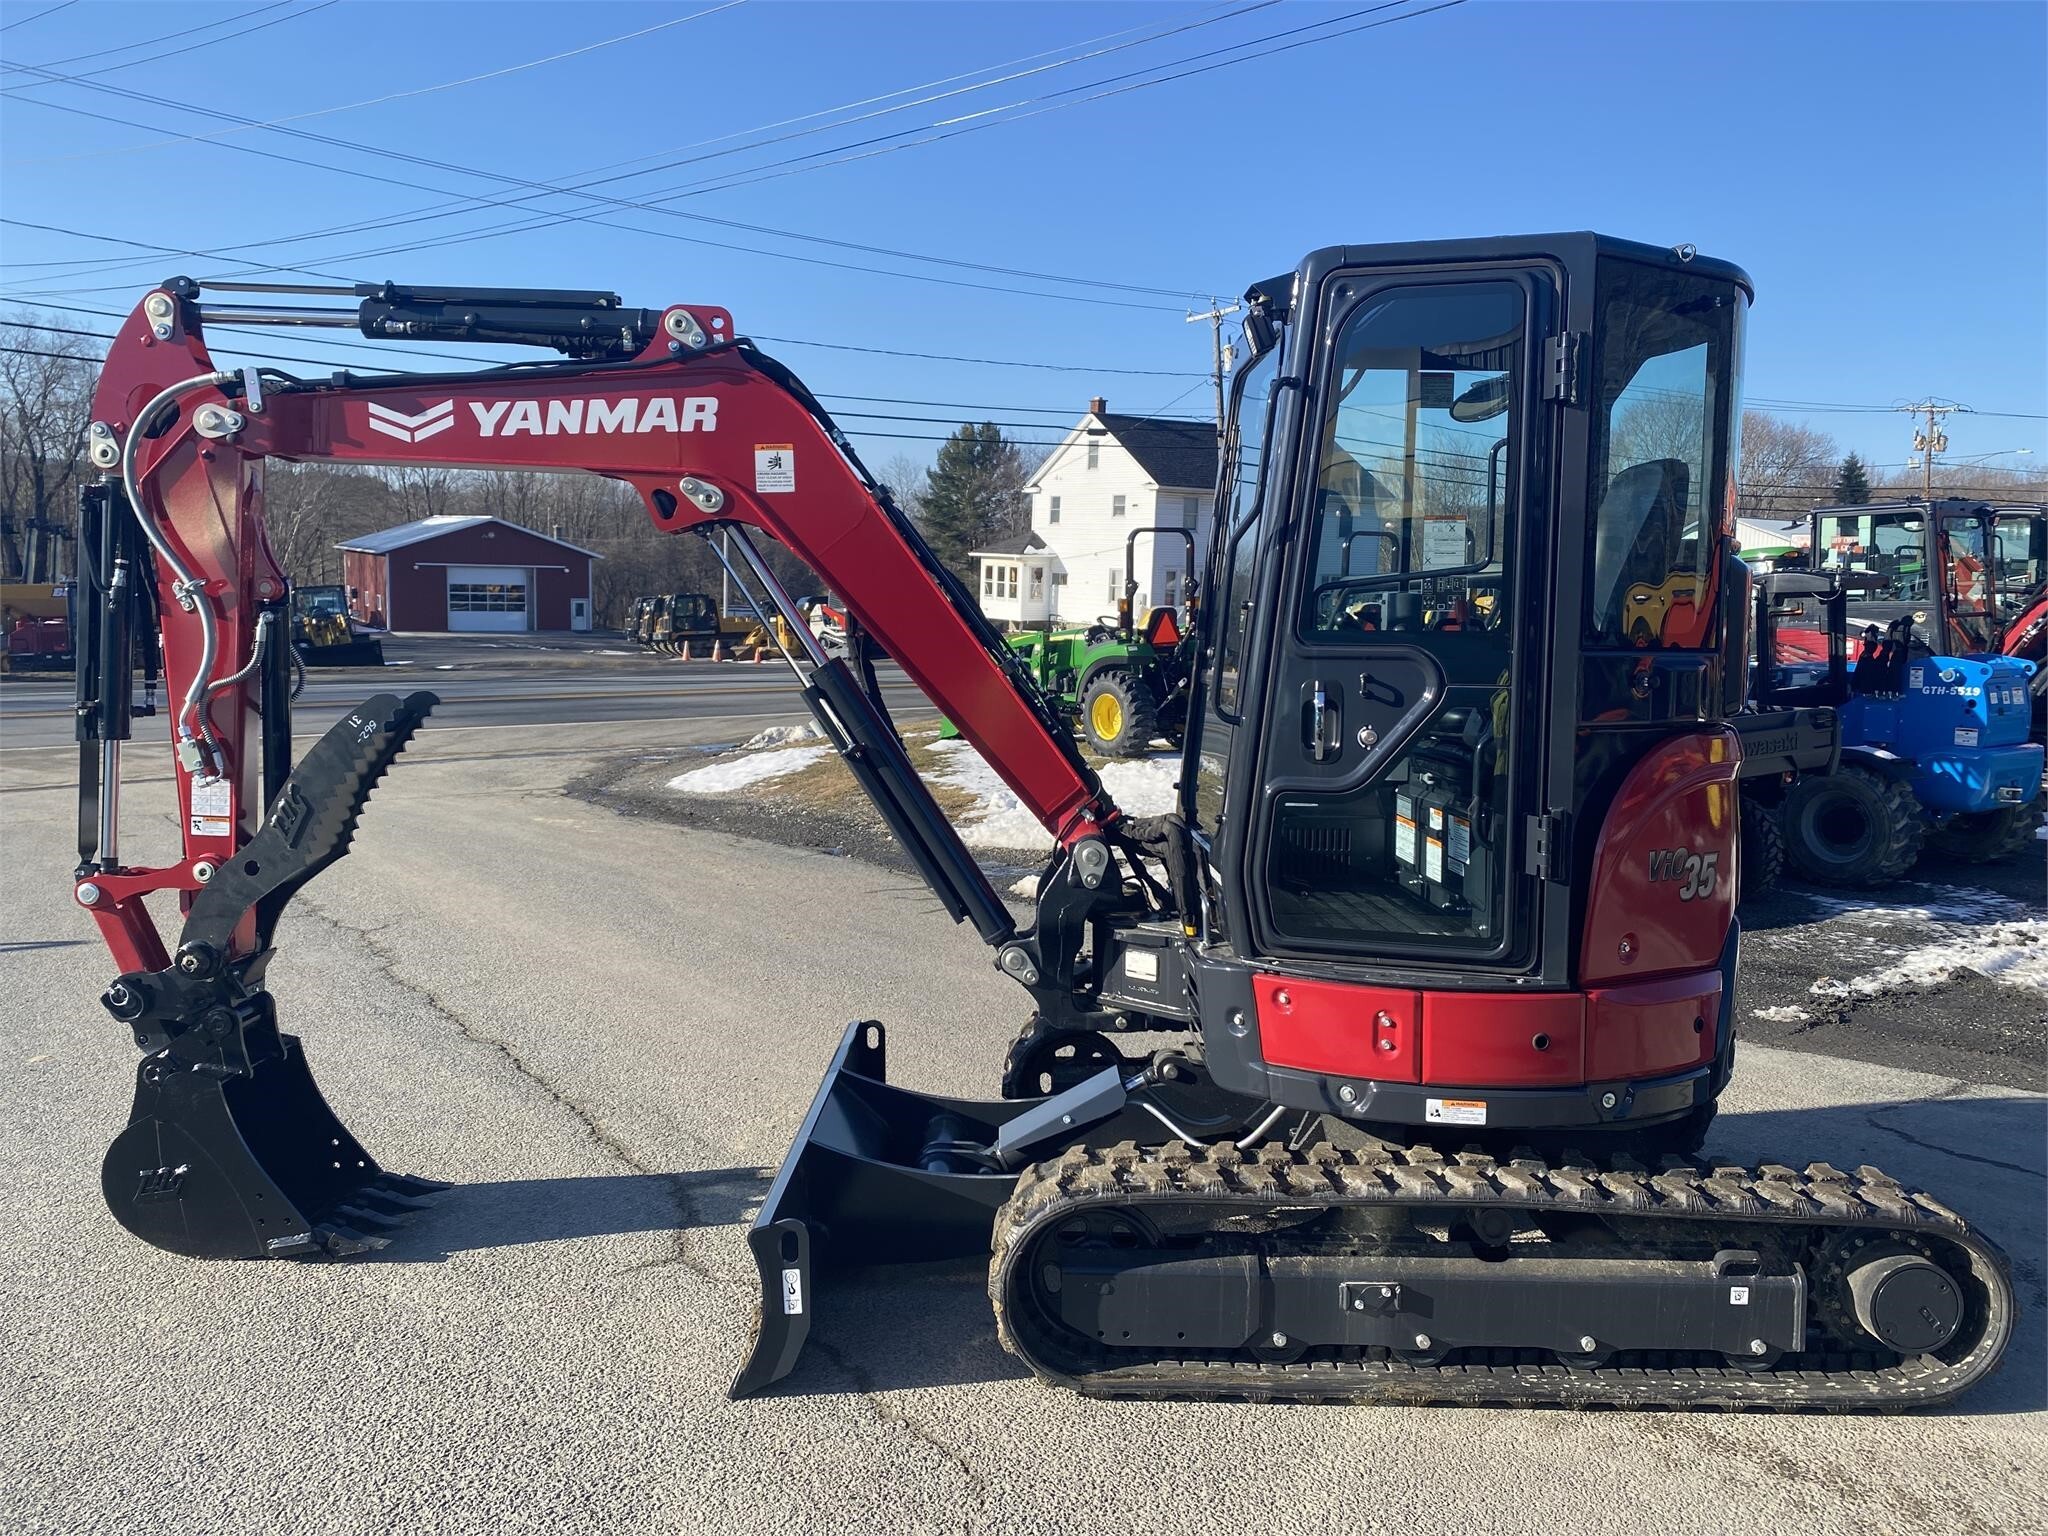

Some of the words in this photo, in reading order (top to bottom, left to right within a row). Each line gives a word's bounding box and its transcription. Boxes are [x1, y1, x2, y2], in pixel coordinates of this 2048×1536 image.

[469, 396, 719, 437] YANMAR
[1922, 686, 1981, 696] GTH-5519
[1744, 732, 1798, 757] wasaki
